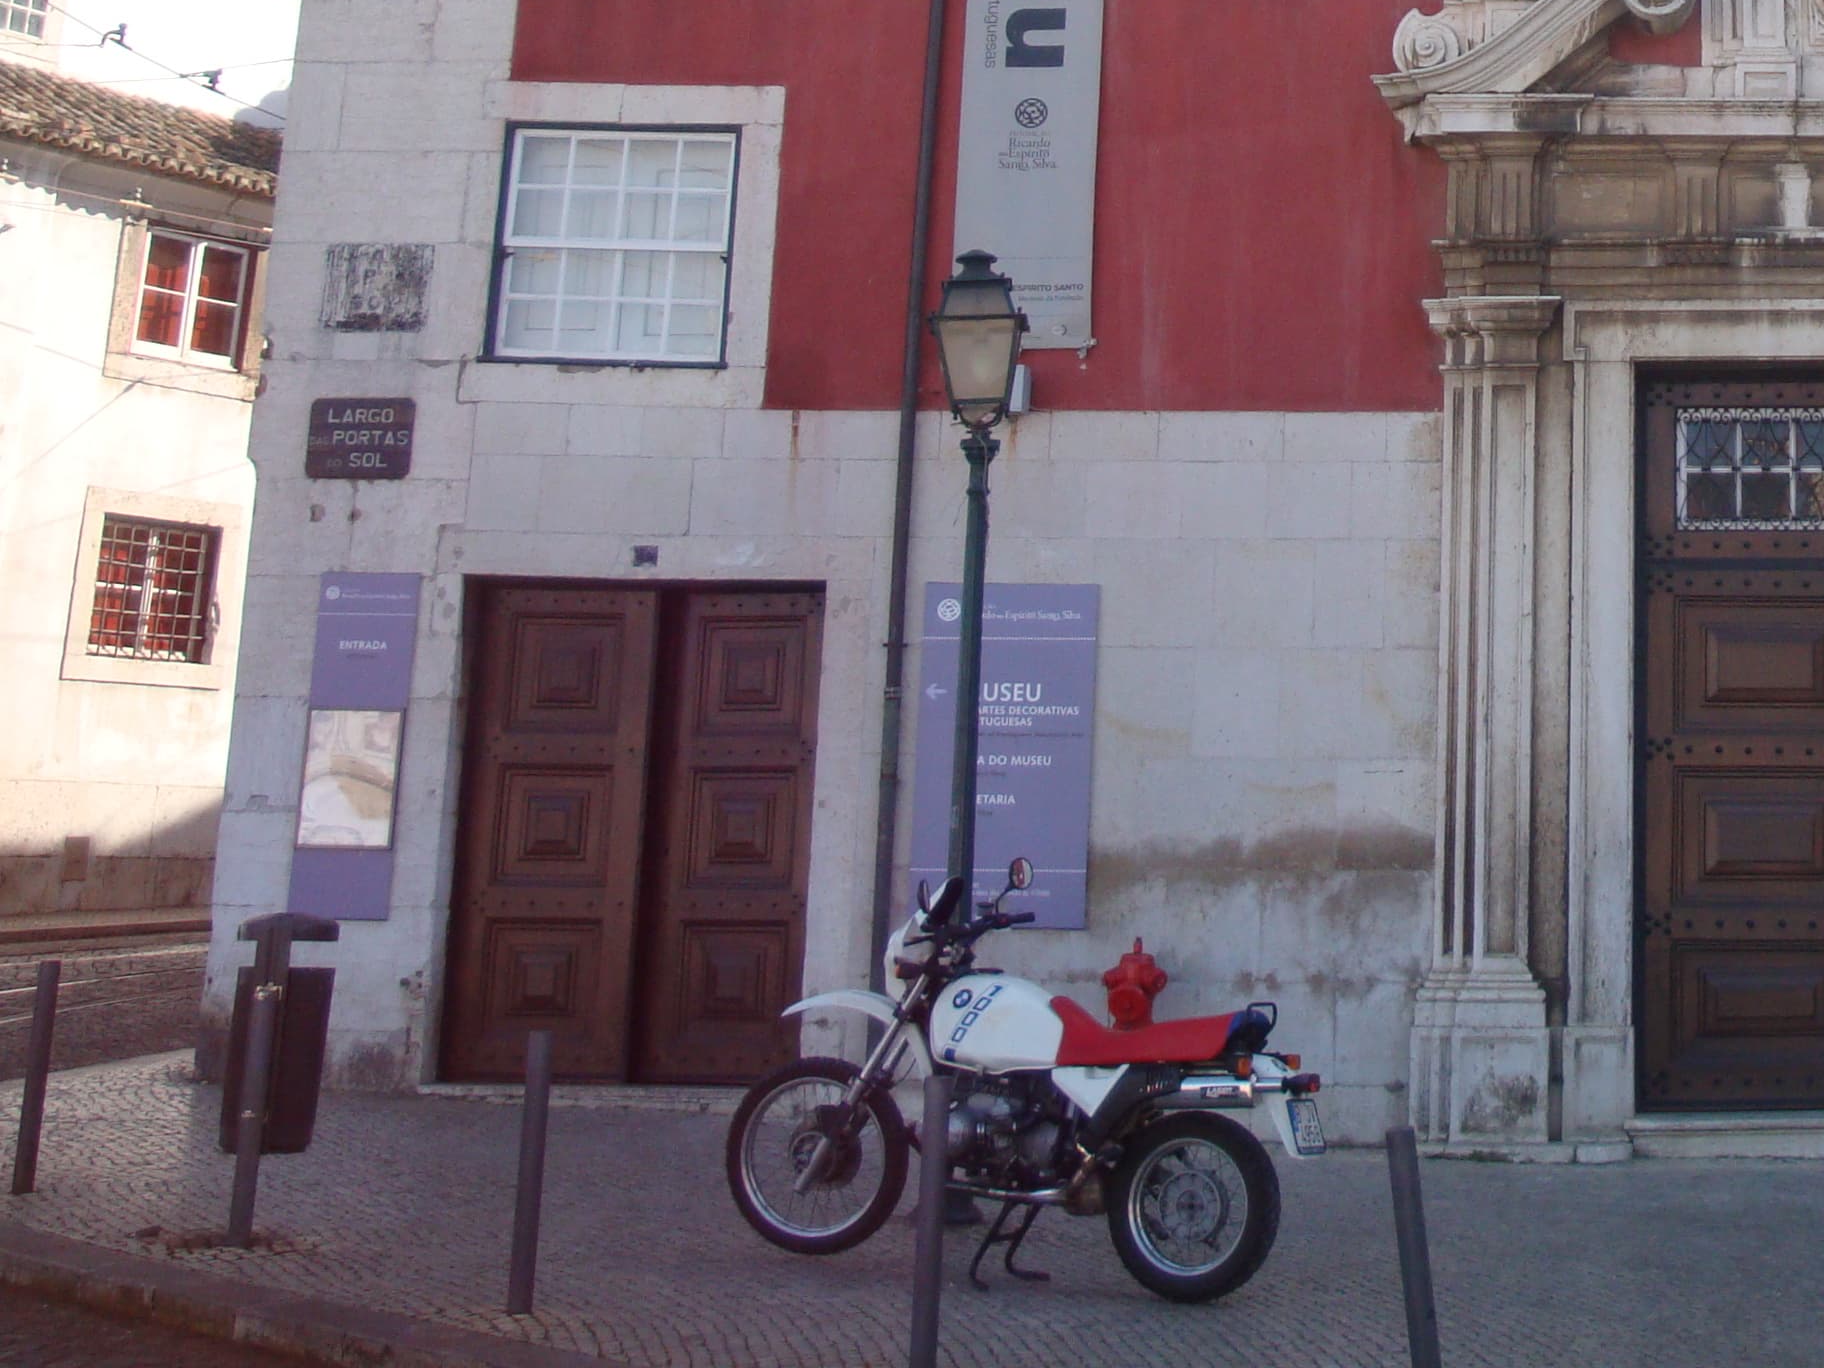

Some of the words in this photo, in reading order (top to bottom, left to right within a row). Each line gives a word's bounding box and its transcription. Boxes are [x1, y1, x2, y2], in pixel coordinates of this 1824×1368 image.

[1054, 283, 1084, 291] SANTO
[327, 408, 394, 423] LARGO
[333, 430, 409, 446] PORTAS
[348, 452, 387, 468] SOL
[339, 640, 388, 650] ENTRADA
[982, 682, 1042, 702] USEU
[1008, 706, 1080, 715] DECORATIVAS
[980, 717, 1032, 727] TUGUESAS
[988, 755, 1008, 765] DO
[1010, 755, 1052, 766] MUSEU
[976, 794, 1016, 805] ETARIA
